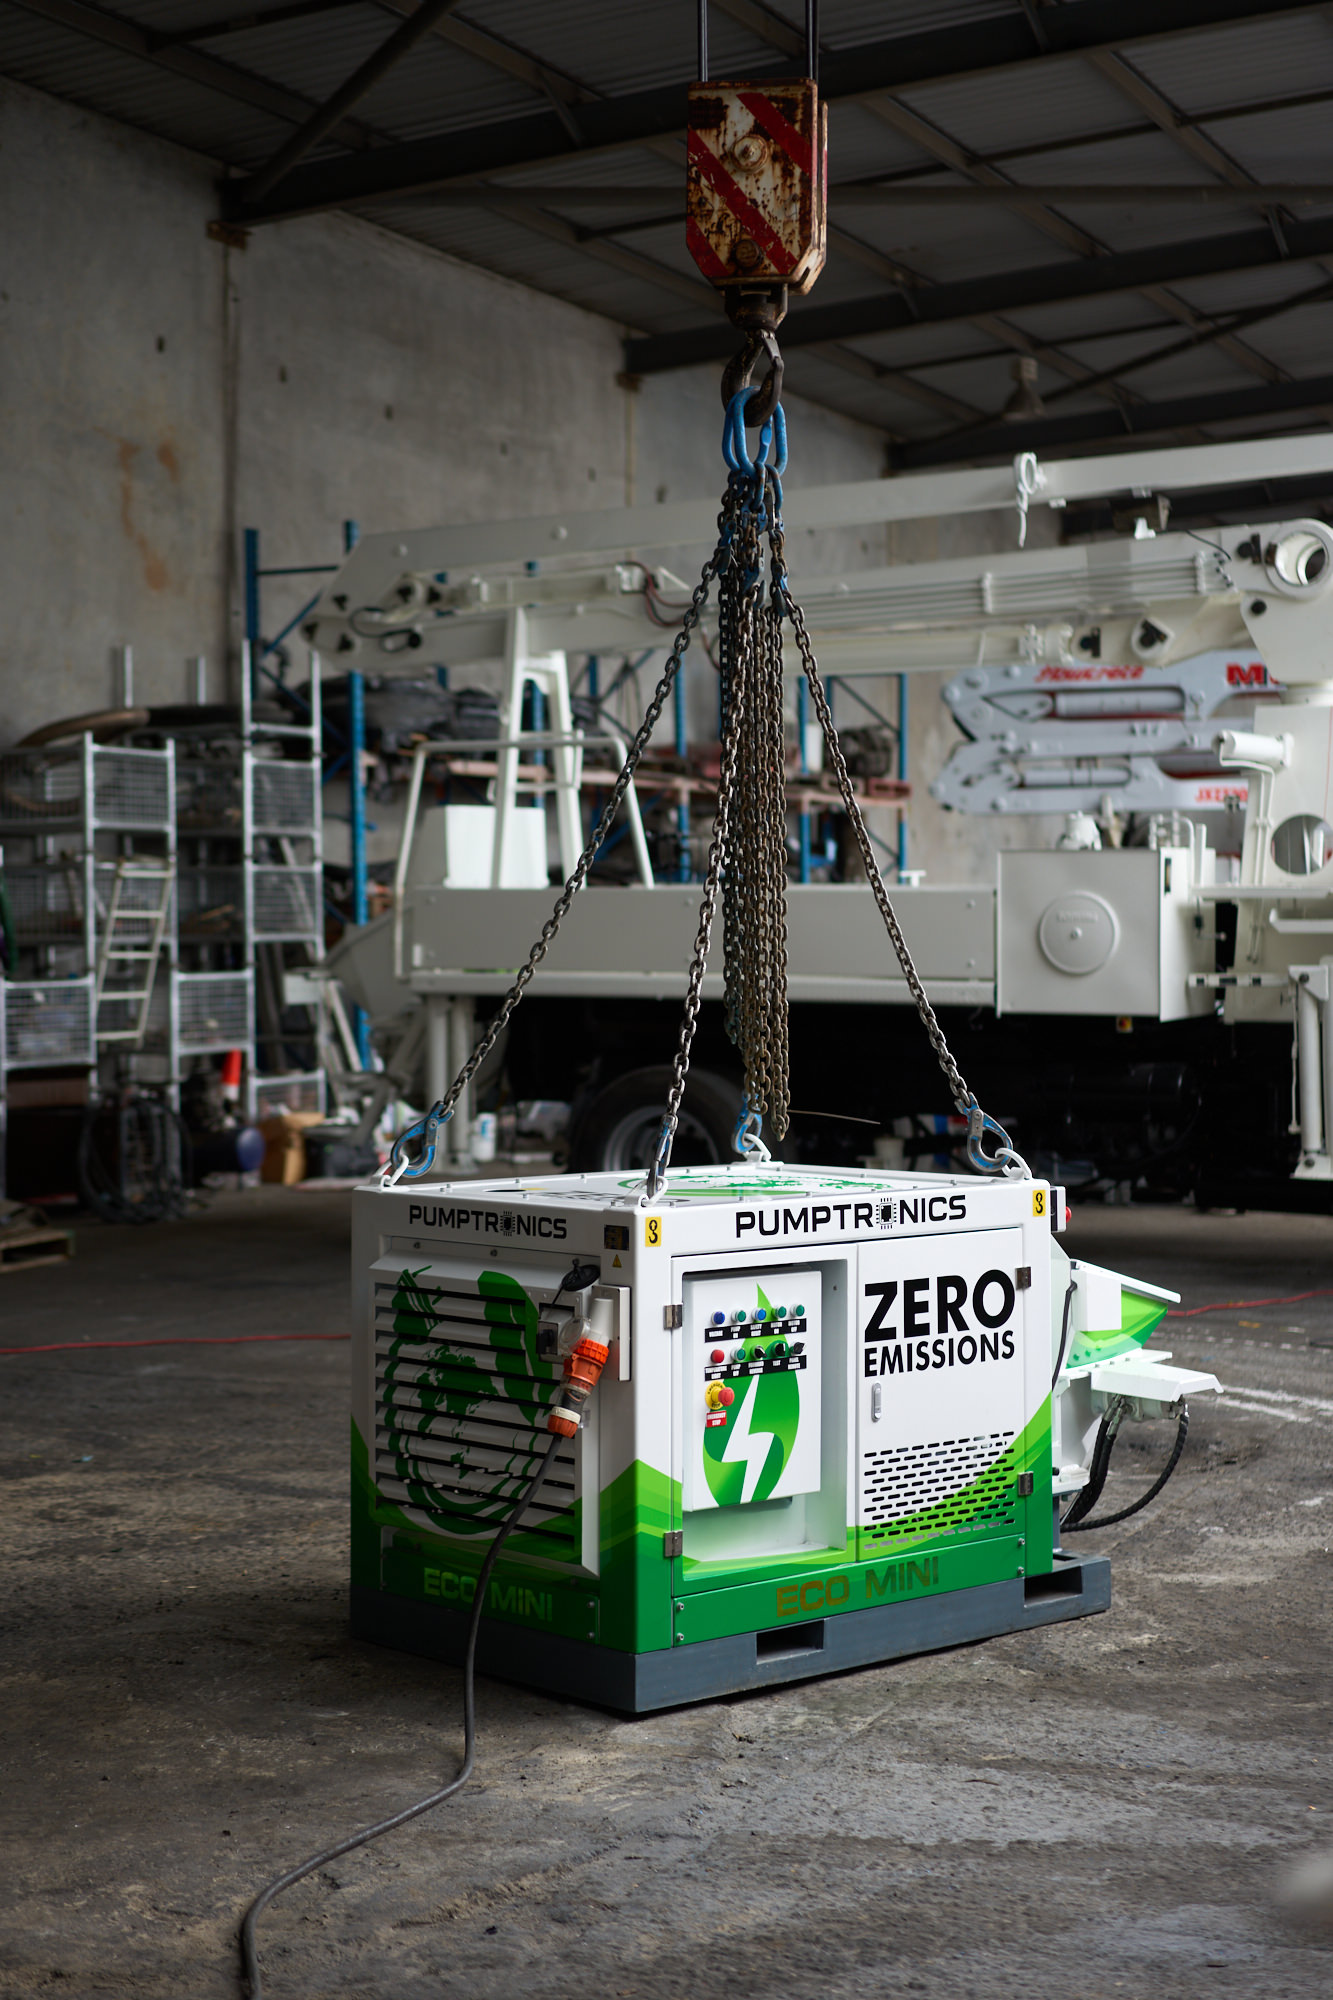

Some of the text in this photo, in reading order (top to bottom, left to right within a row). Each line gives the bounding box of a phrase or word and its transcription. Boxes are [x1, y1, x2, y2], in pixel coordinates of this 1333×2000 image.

[864, 1269, 1016, 1343] ZERO
[864, 1330, 1015, 1377] EMISSIONS
[423, 1567, 552, 1622] ECO MINI
[776, 1556, 939, 1617] ECO MINI
